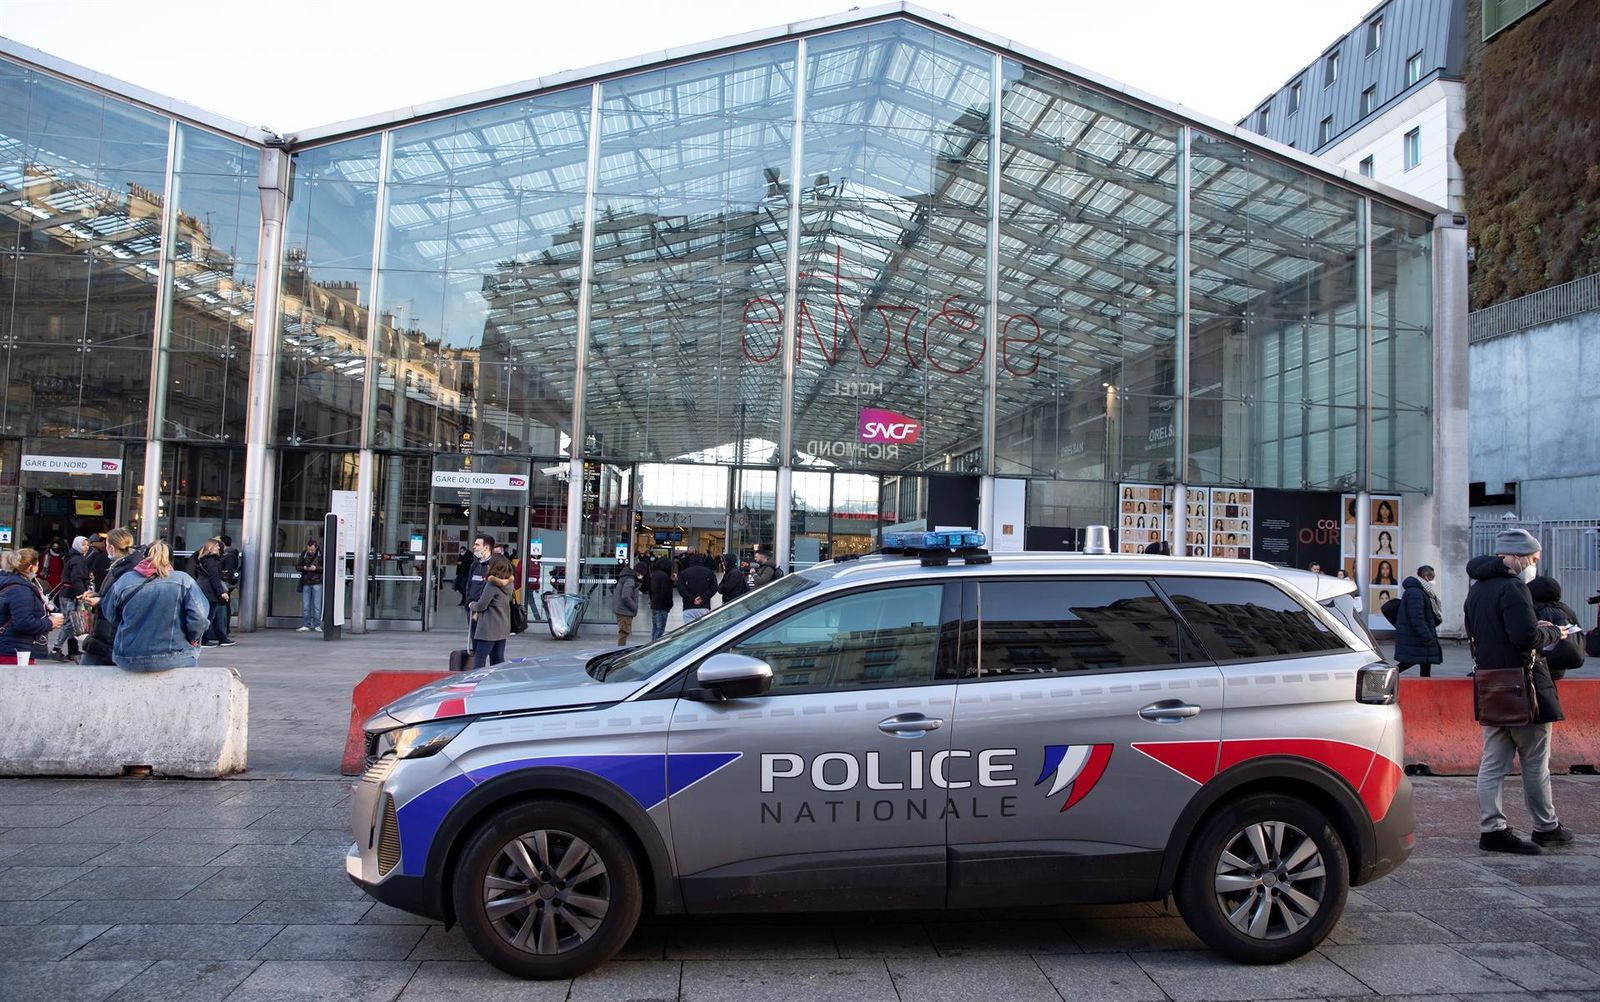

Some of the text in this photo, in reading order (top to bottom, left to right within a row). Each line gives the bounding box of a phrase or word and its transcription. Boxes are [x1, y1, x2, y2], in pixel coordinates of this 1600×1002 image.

[862, 422, 918, 440] SNCF
[25, 459, 118, 471] GARE DU NORD SNCF
[435, 475, 457, 483] GARE
[458, 476, 471, 484] DU
[472, 477, 496, 485] NORD
[1317, 519, 1340, 530] COL
[1298, 527, 1340, 545] OUR
[759, 748, 1019, 793] POLICE
[761, 796, 1018, 824] NATIONALE
